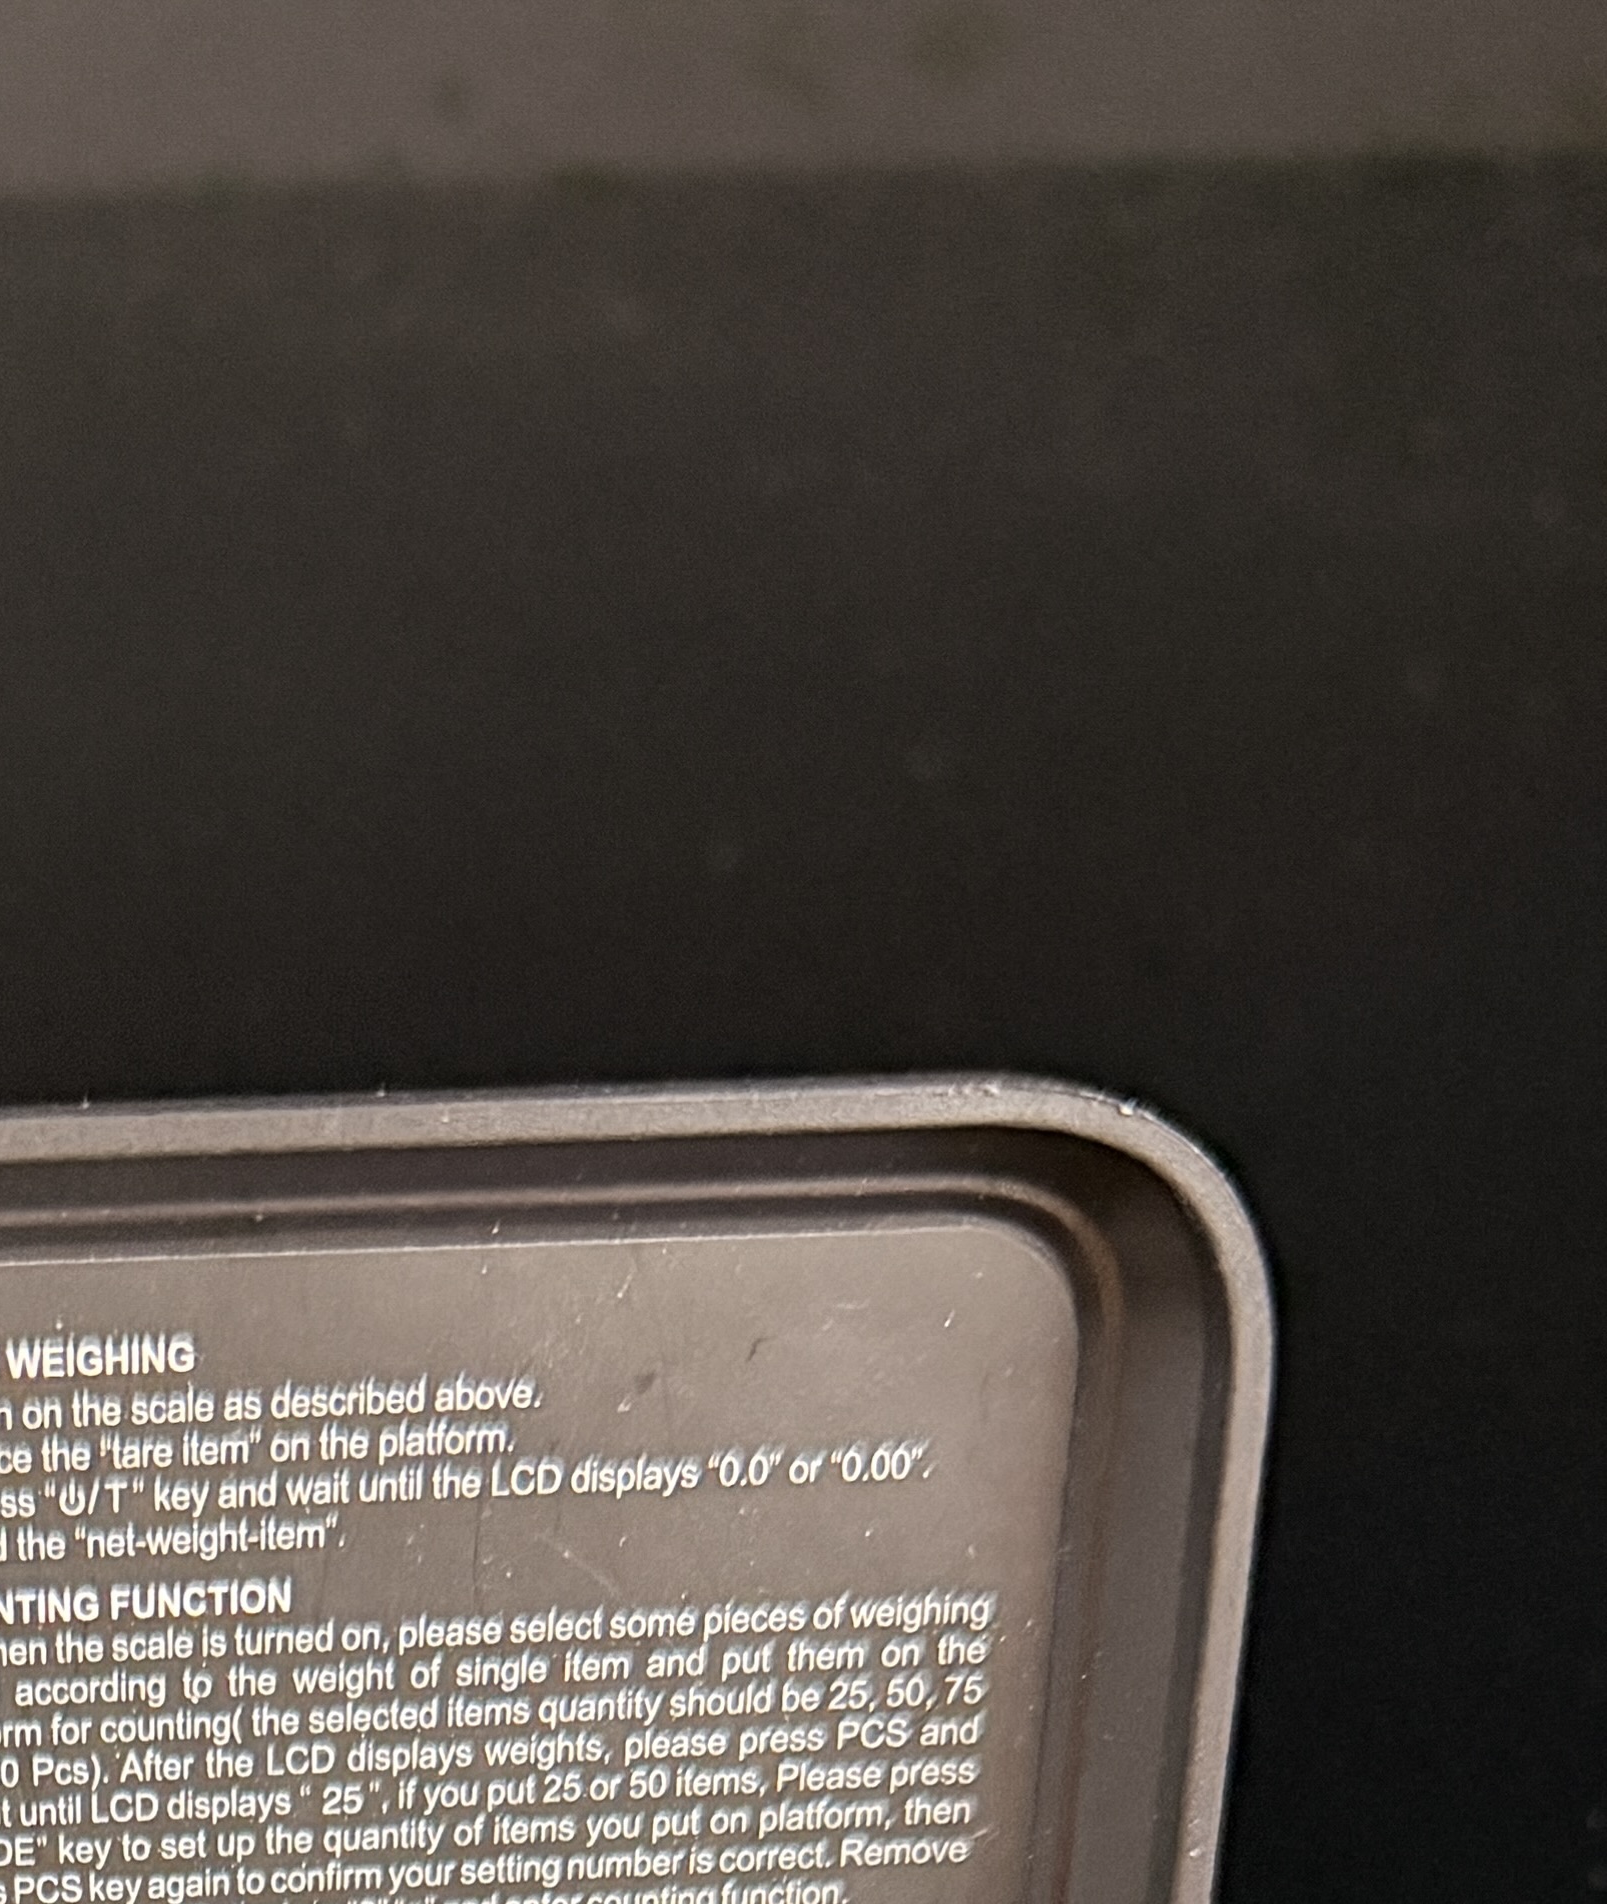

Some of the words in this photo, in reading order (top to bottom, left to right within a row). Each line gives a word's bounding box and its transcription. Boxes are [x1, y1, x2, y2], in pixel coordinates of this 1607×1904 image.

[8, 1340, 194, 1379] WEIGHING
[22, 1406, 62, 1430] on
[72, 1397, 121, 1428] the
[132, 1393, 214, 1425] scale
[224, 1397, 261, 1421] as
[271, 1384, 425, 1419] described
[435, 1379, 542, 1412] above.
[17, 1530, 65, 1560] the
[111, 1583, 291, 1620] FUNCTION
[33, 1755, 108, 1792] Pcs).
[120, 1751, 194, 1783] After
[206, 1749, 253, 1779] the
[267, 1745, 335, 1776] LCD
[348, 1739, 473, 1778] displays
[485, 1732, 612, 1772] weights,
[624, 1727, 729, 1766] please
[739, 1729, 828, 1761] press
[837, 1719, 913, 1750] PCS
[920, 1716, 983, 1747] and
